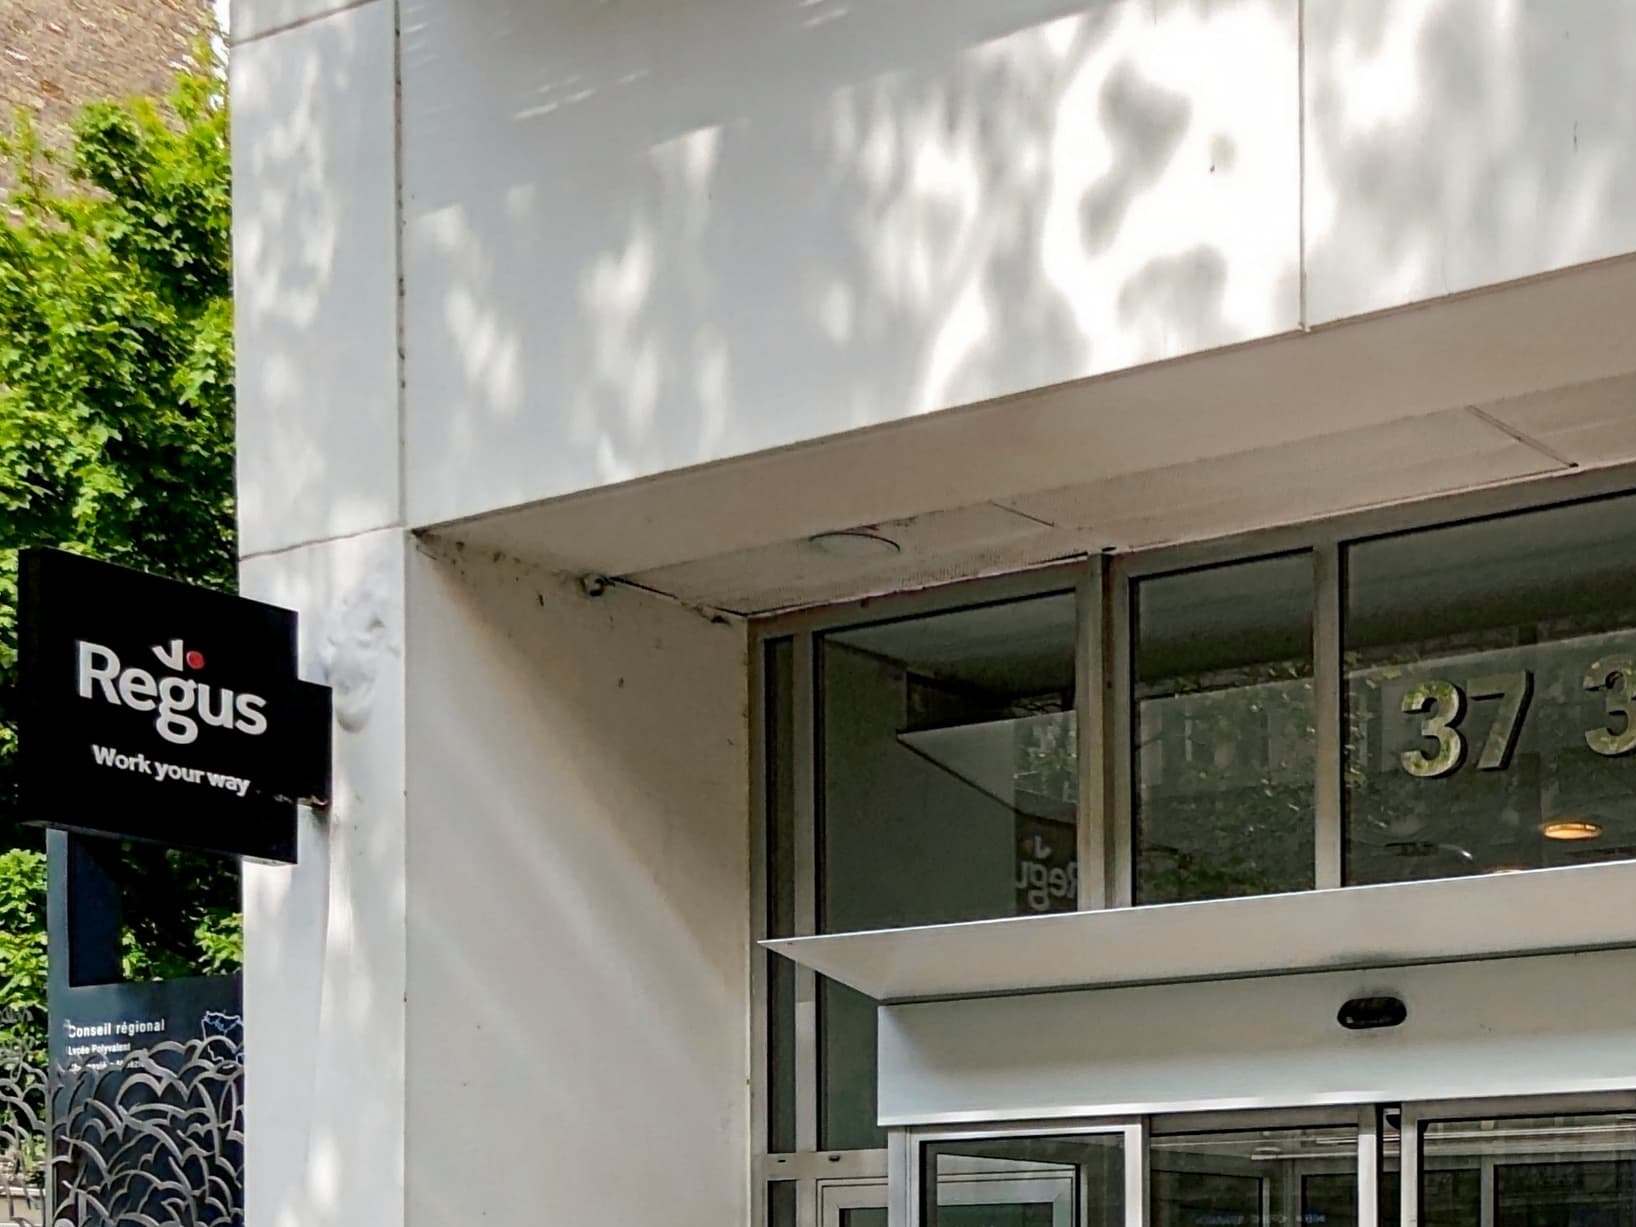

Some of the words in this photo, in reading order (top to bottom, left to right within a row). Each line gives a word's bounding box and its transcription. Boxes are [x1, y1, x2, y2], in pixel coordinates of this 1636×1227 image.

[76, 640, 267, 744] Regus
[1401, 670, 1533, 778] 37
[92, 744, 152, 774] Work
[155, 761, 204, 781] your
[207, 770, 250, 797] way
[68, 1022, 111, 1038] Conseil
[116, 1018, 165, 1036] régional
